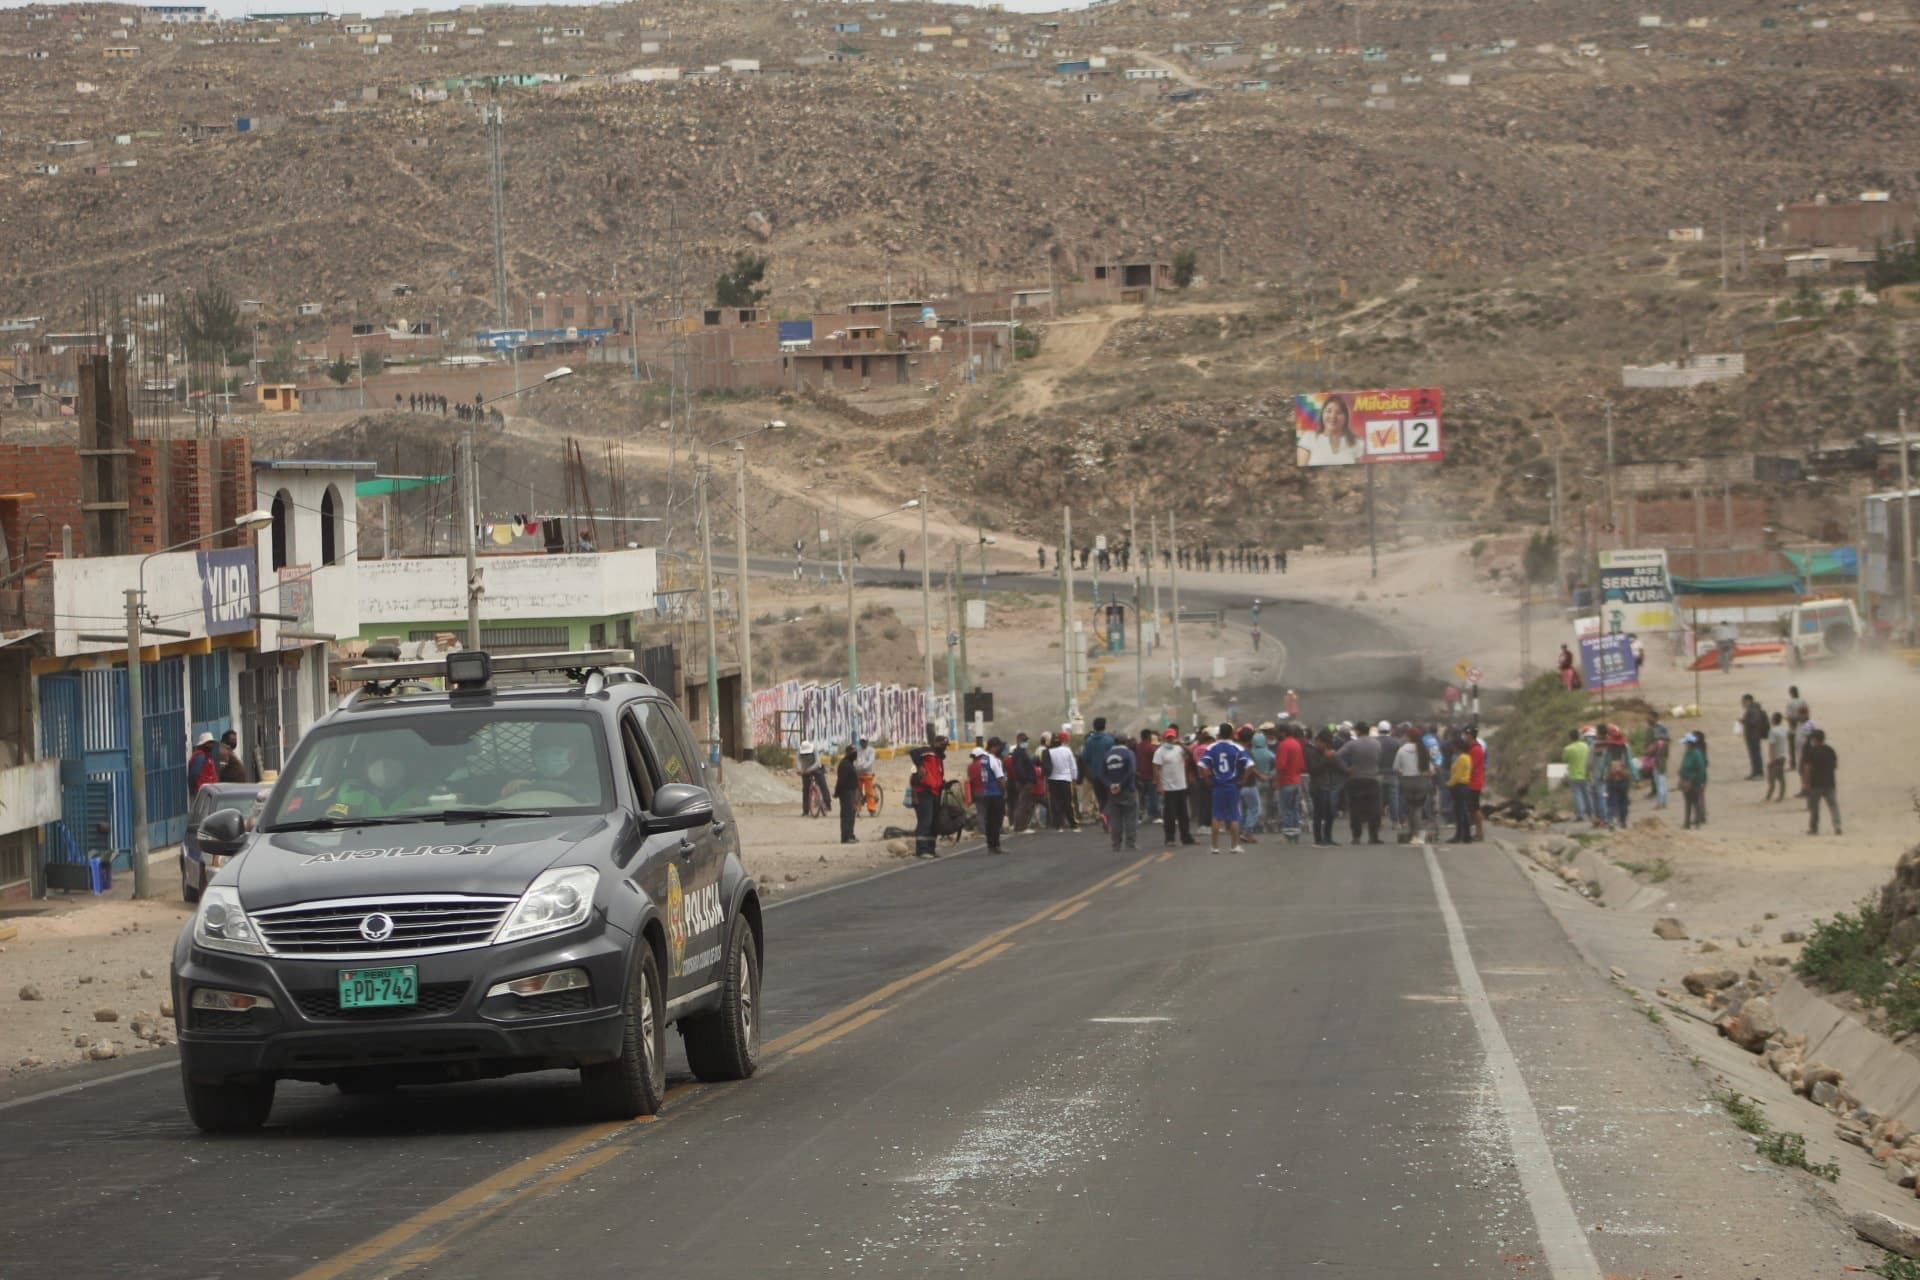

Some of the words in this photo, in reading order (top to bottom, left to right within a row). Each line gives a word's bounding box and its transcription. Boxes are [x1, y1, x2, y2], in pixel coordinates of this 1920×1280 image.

[1412, 422, 1430, 448] 2
[206, 564, 251, 623] YURA
[1625, 590, 1664, 601] YURA
[1219, 752, 1230, 773] 5
[684, 882, 725, 937] POLICIA
[364, 970, 391, 979] PERU
